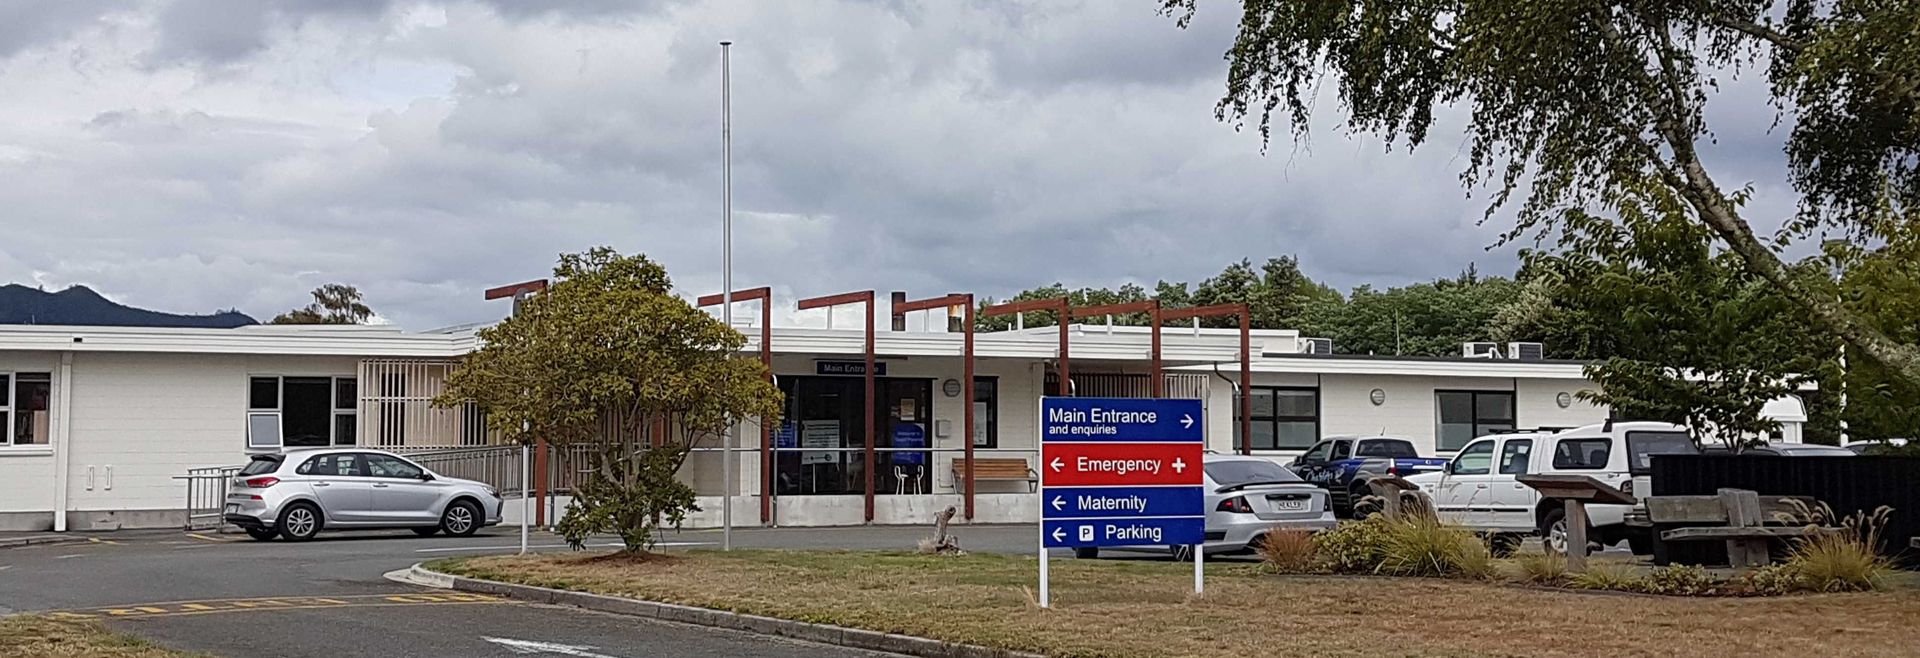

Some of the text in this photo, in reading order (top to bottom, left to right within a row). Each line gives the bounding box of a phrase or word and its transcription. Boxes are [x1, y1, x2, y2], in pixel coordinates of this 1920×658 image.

[824, 364, 879, 373] Main Entrae
[1049, 408, 1157, 423] Main Entrance
[1049, 425, 1117, 437] and enquiries
[1077, 456, 1161, 476] Emergency
[1078, 495, 1147, 513] Maternity
[1106, 524, 1162, 542] Parking
